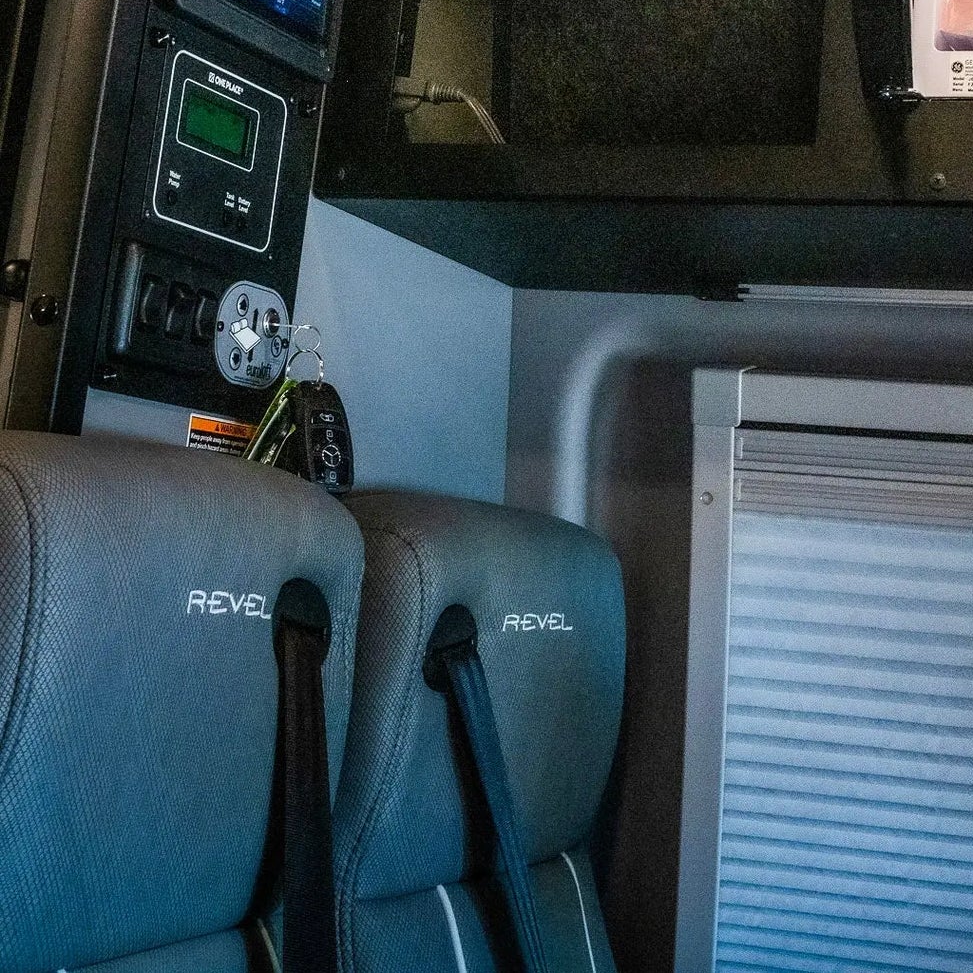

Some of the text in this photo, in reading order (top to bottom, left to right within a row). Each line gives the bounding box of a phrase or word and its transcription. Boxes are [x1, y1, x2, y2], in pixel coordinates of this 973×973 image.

[220, 424, 248, 436] WARNING
[190, 432, 200, 441] Keep
[200, 434, 212, 442] people
[213, 436, 222, 444] away
[187, 590, 272, 620] REVEL
[502, 613, 573, 632] REVEL
